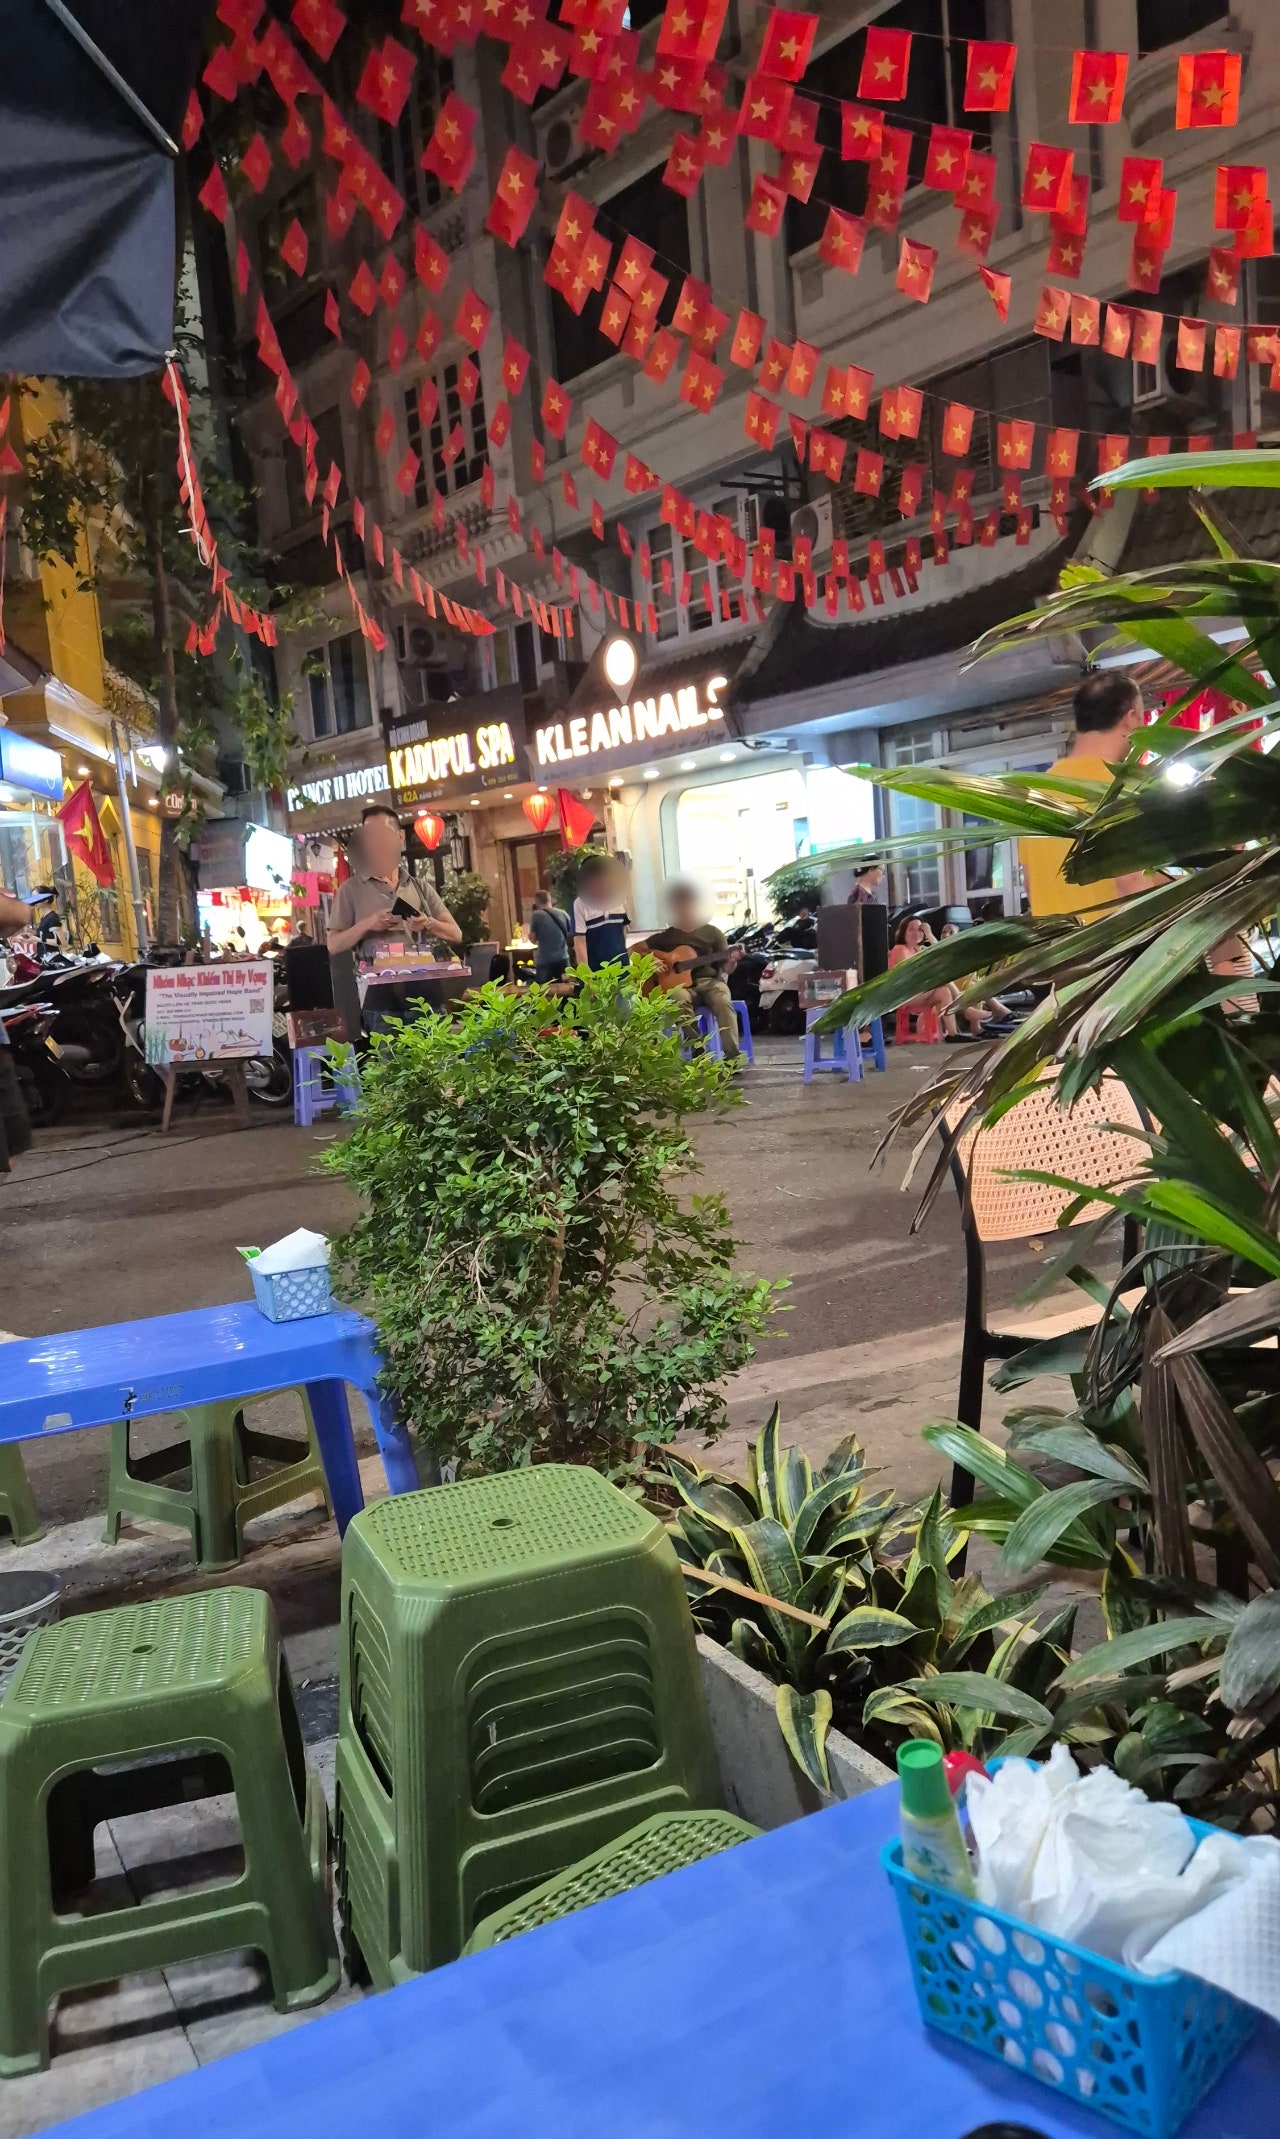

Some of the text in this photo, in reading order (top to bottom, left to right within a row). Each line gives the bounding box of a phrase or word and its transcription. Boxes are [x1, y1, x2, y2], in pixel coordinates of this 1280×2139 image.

[389, 722, 515, 789] KADUPUL SPA
[345, 764, 391, 798] HOTEL
[403, 790, 418, 804] 42A
[222, 970, 234, 987] Thị
[235, 969, 246, 987] Hy
[247, 968, 267, 986] Vọng
[174, 991, 197, 999] Visually
[199, 989, 225, 997] Impaired
[226, 988, 243, 996] Hope
